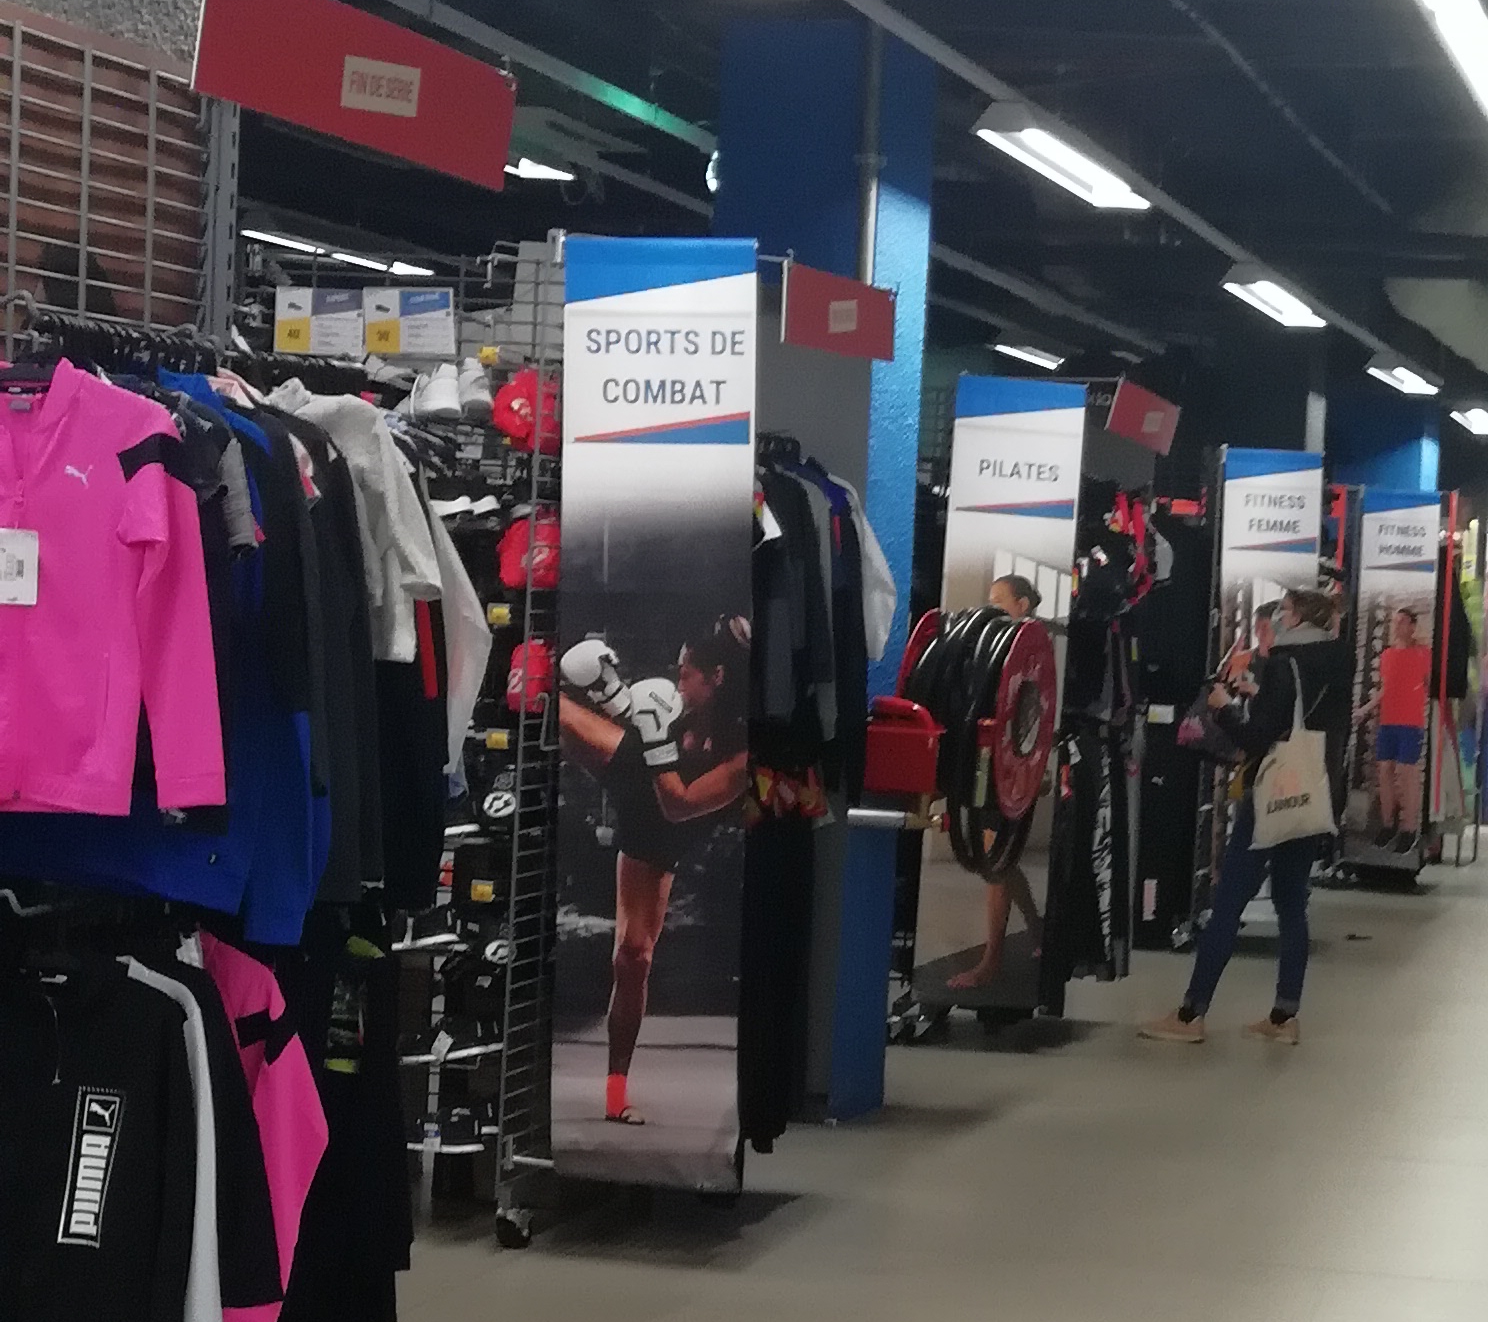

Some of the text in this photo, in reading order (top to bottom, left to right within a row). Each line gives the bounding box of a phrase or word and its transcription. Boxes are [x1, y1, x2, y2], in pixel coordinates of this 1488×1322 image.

[585, 328, 746, 356] SPORTS DE
[602, 378, 728, 405] COMBAT
[978, 458, 1061, 482] PILATES
[1243, 492, 1307, 510] FITNESS
[1248, 517, 1301, 535] FEMME
[1377, 523, 1427, 538] FITNESS
[68, 1133, 112, 1237] PUMA
